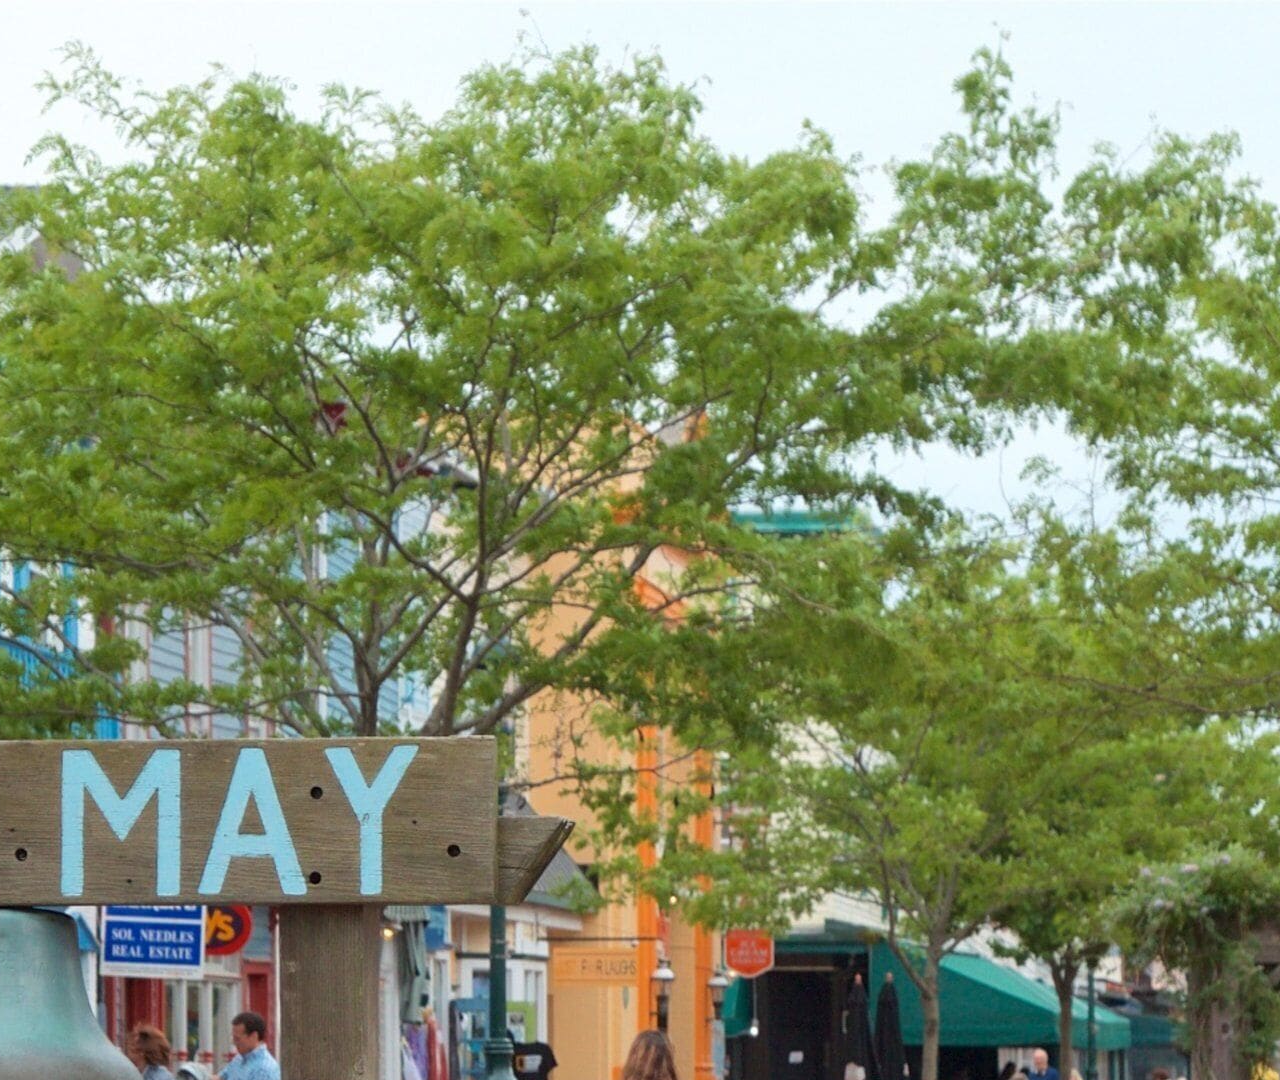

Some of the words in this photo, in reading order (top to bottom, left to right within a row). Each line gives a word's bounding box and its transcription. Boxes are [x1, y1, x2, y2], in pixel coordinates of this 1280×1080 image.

[60, 745, 419, 896] MAY
[112, 928, 134, 941] SOL
[139, 928, 194, 943] NEEDLES
[111, 944, 144, 958] REAL
[148, 945, 193, 960] ESTATE
